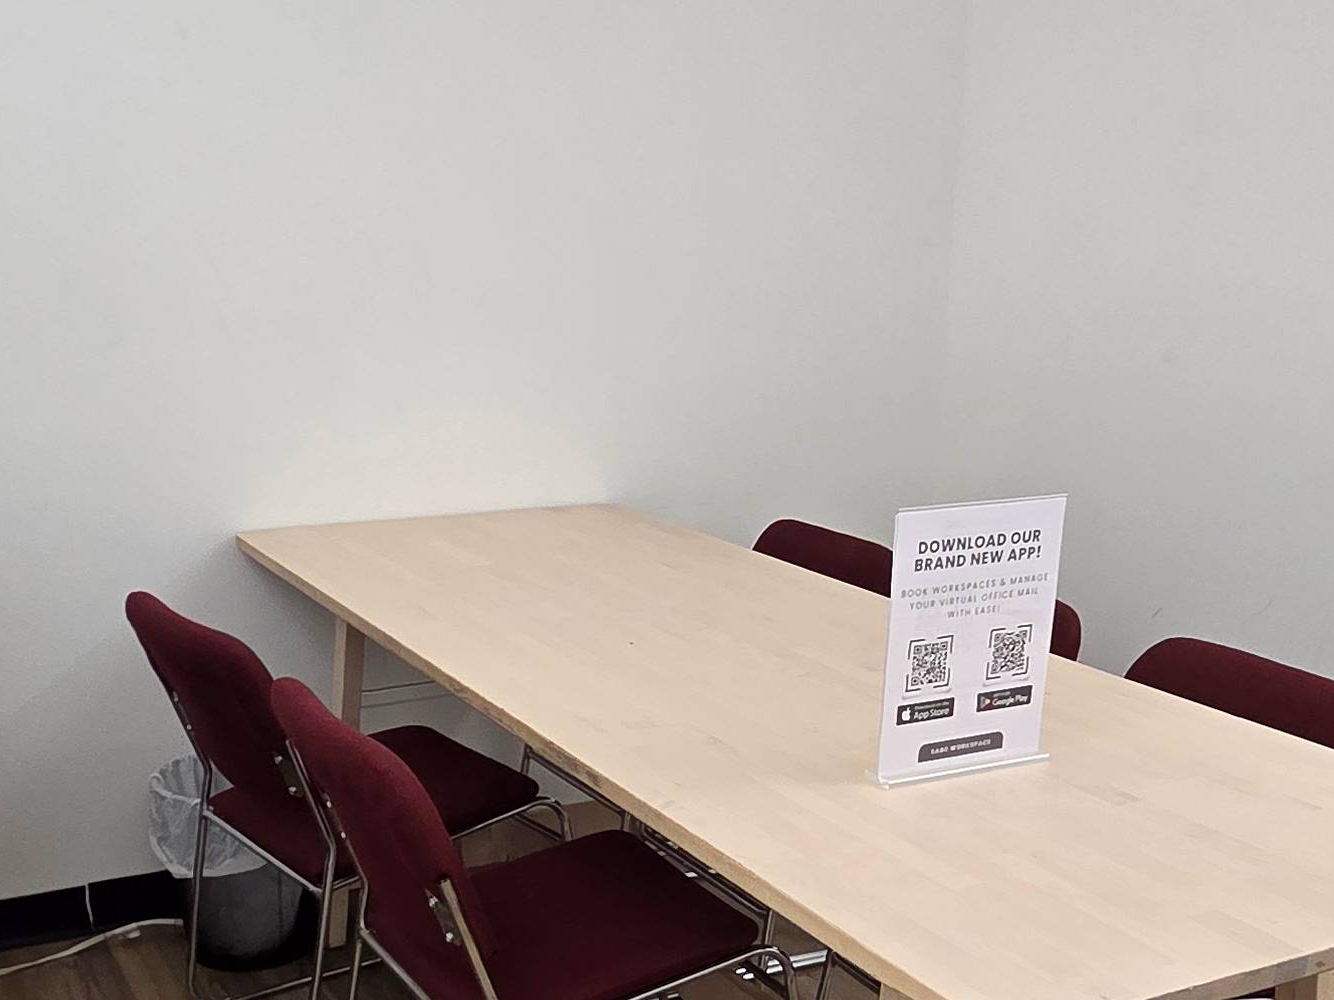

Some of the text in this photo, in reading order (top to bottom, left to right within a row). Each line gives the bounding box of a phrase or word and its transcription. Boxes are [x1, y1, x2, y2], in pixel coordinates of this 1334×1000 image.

[918, 529, 1042, 555] DOWNLOAD OUR
[914, 545, 1042, 572] BRAND NEW APP!
[901, 588, 928, 598] BOOK
[932, 578, 996, 595] WORKSPACES
[1010, 572, 1049, 584] MANAGE
[909, 587, 1038, 611] YOUR VIRTUAL OFFICE MAIL
[947, 604, 1001, 618] WITH EASE!
[992, 696, 1015, 706] Google
[1014, 694, 1028, 703] Play
[914, 708, 950, 720] App Store
